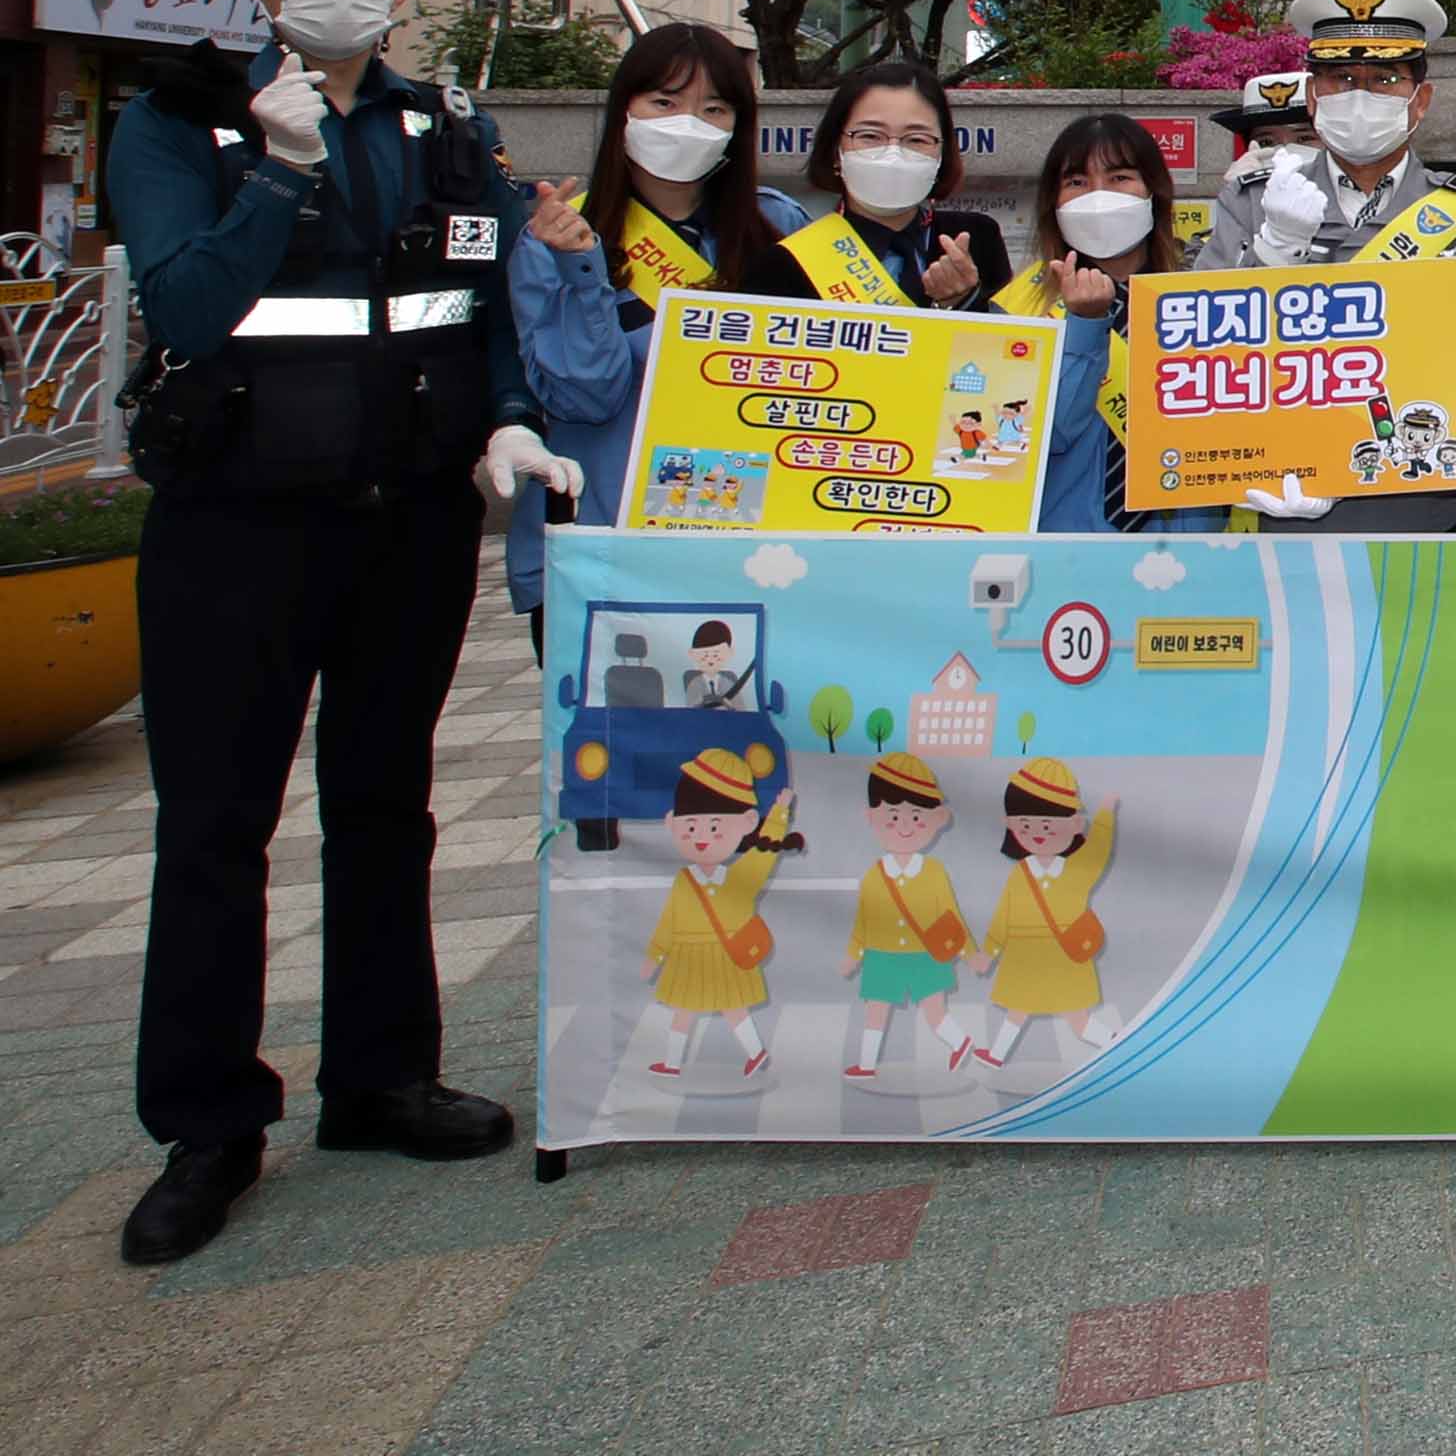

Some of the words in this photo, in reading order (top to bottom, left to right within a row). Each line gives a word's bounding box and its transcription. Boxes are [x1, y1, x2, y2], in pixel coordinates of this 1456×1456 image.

[1153, 133, 1185, 150] 스원
[681, 307, 754, 343] 길을
[766, 314, 912, 355] 건널때는
[1156, 289, 1269, 351] 뛰지
[1276, 281, 1386, 344] 않고
[728, 357, 815, 387] 멈춘다
[1156, 355, 1269, 416] 건너
[1274, 346, 1387, 410] 가요
[765, 399, 851, 429] 살핀다
[792, 440, 841, 467] 손을
[849, 444, 899, 471] 든다
[828, 481, 936, 514] 확인한다
[1060, 627, 1093, 661] 30
[1149, 633, 1189, 655] 어린이
[1193, 632, 1245, 655] 보호구역
